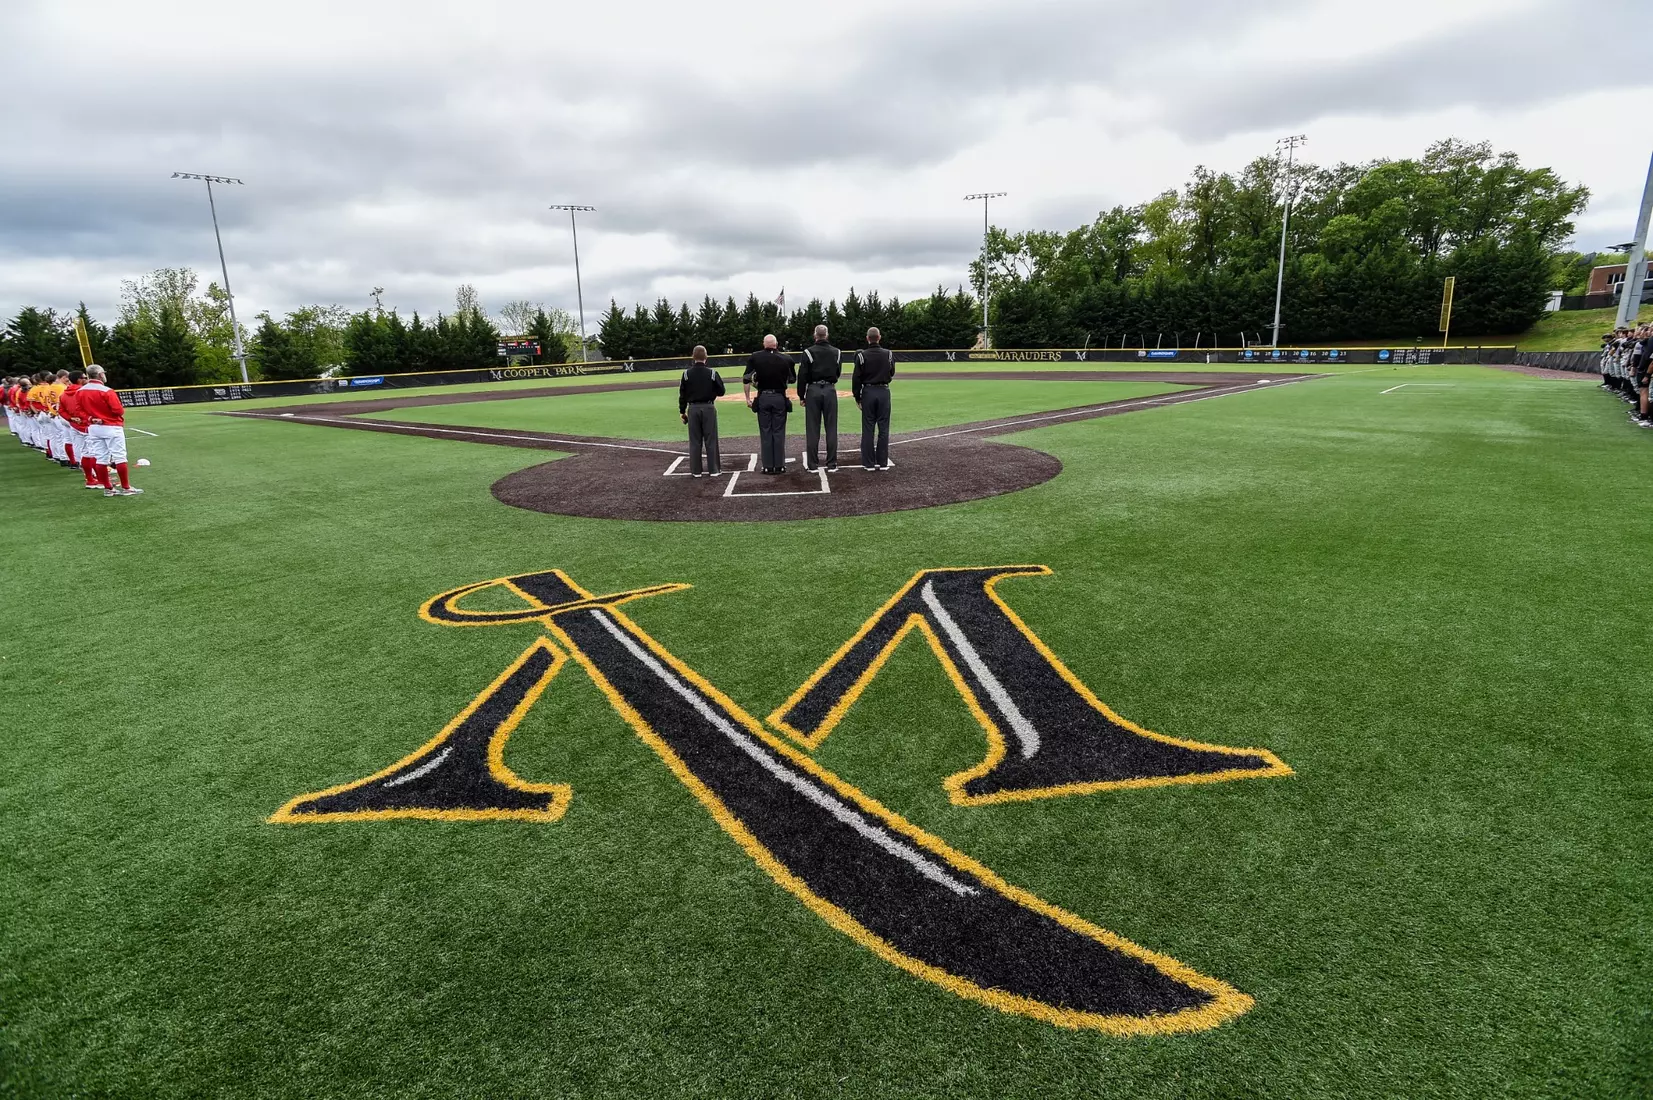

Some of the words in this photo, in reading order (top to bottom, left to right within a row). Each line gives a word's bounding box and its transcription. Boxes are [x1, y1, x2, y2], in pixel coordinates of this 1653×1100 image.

[995, 350, 1062, 361] MARAUDERS
[504, 367, 551, 378] COOPER
[555, 365, 587, 375] PARK
